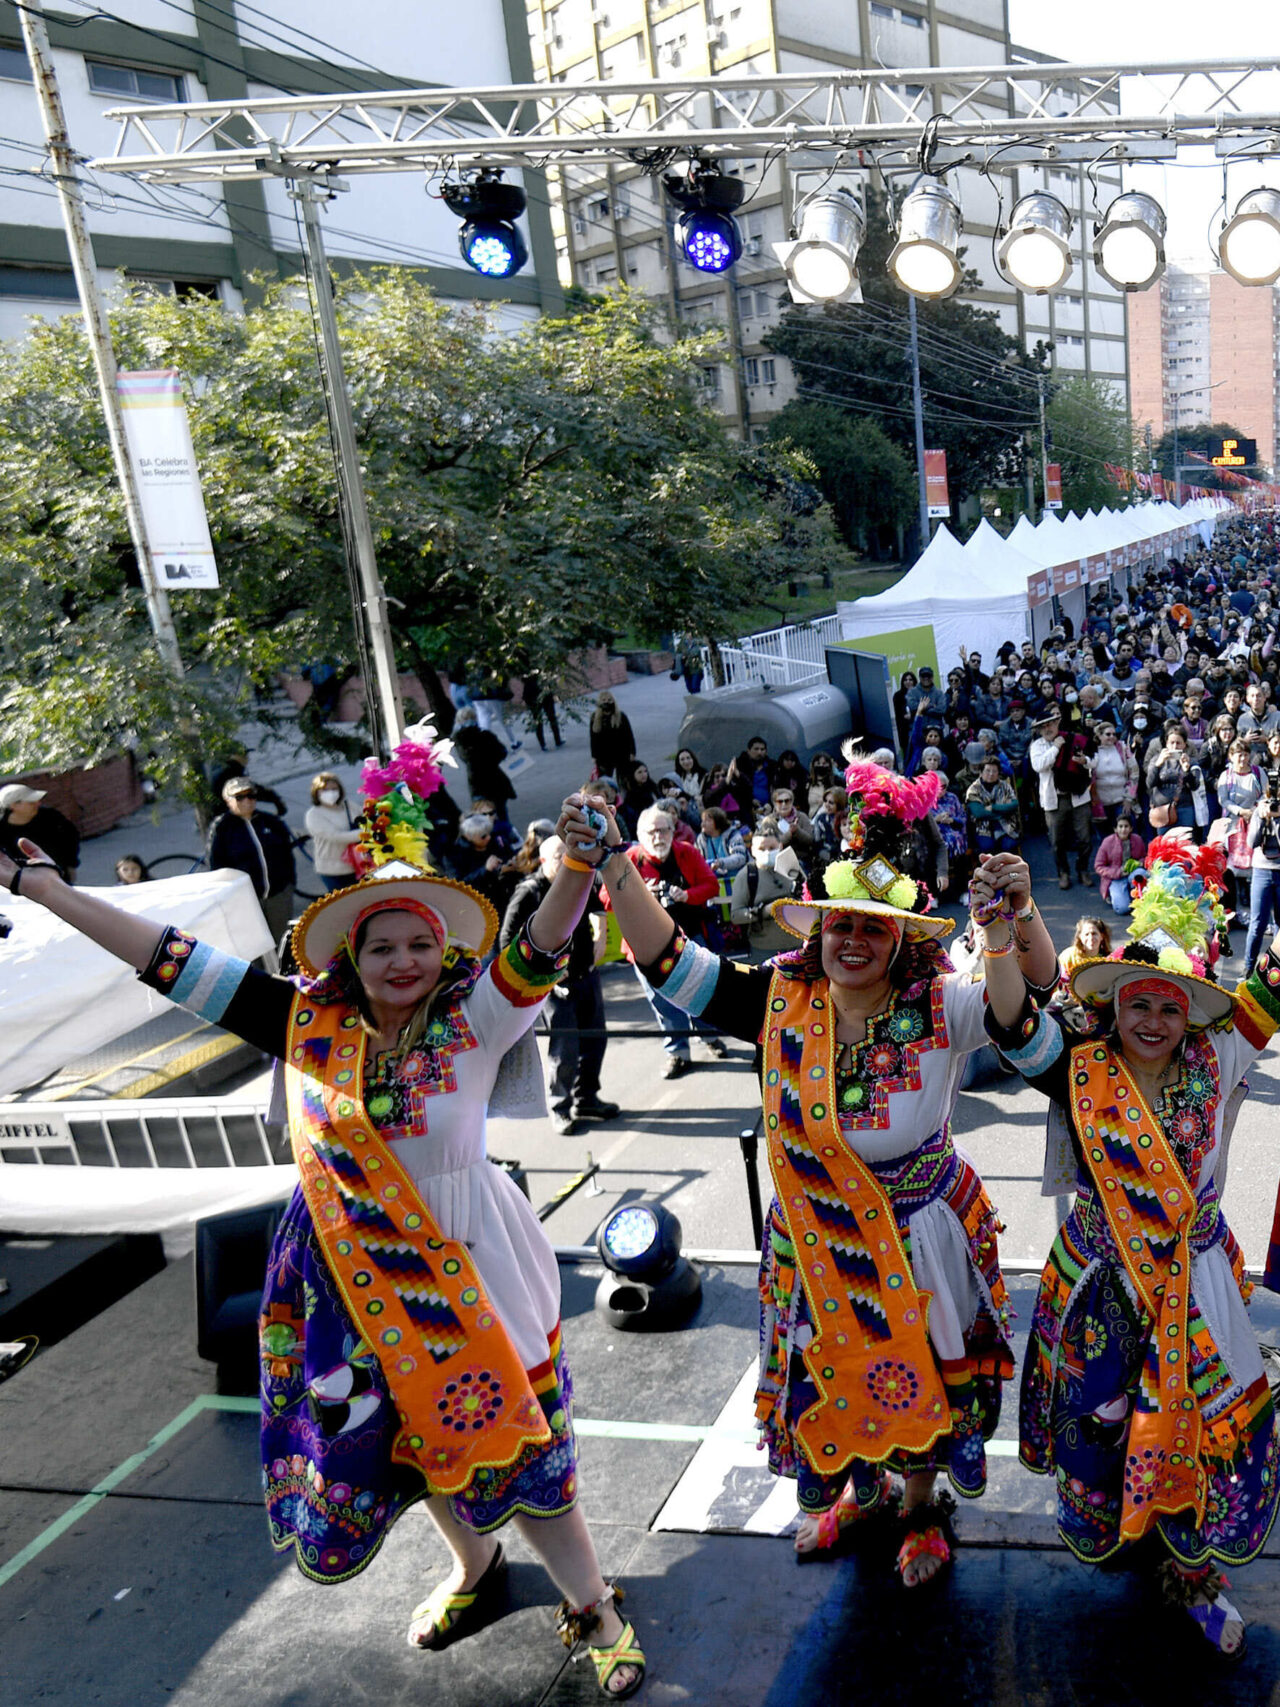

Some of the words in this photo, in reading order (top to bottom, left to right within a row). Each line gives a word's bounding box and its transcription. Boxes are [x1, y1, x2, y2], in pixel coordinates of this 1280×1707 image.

[139, 458, 153, 467] BA
[154, 457, 189, 467] Celebra
[154, 468, 191, 477] Regiones
